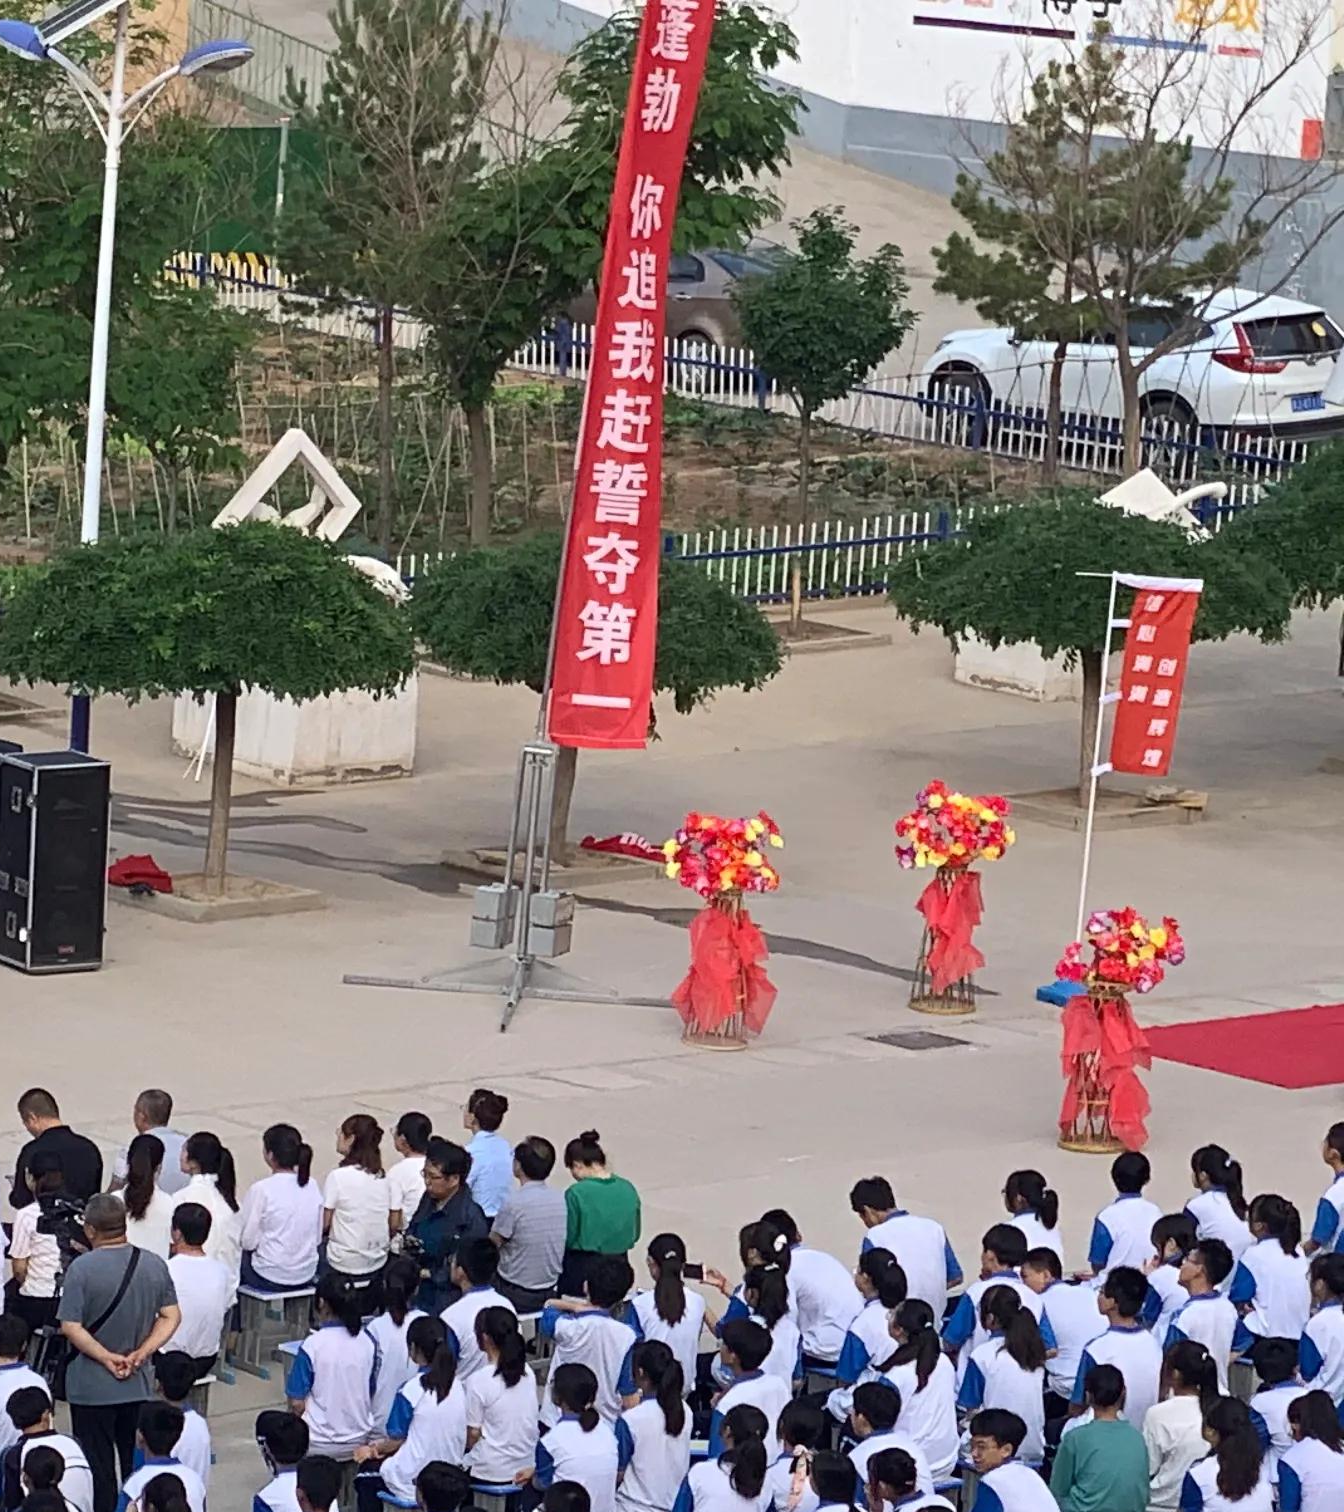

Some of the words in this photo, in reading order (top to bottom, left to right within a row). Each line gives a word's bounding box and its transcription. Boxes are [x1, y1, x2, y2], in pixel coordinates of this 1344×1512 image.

[570, 172, 666, 710] 你追我赶誓夺第一
